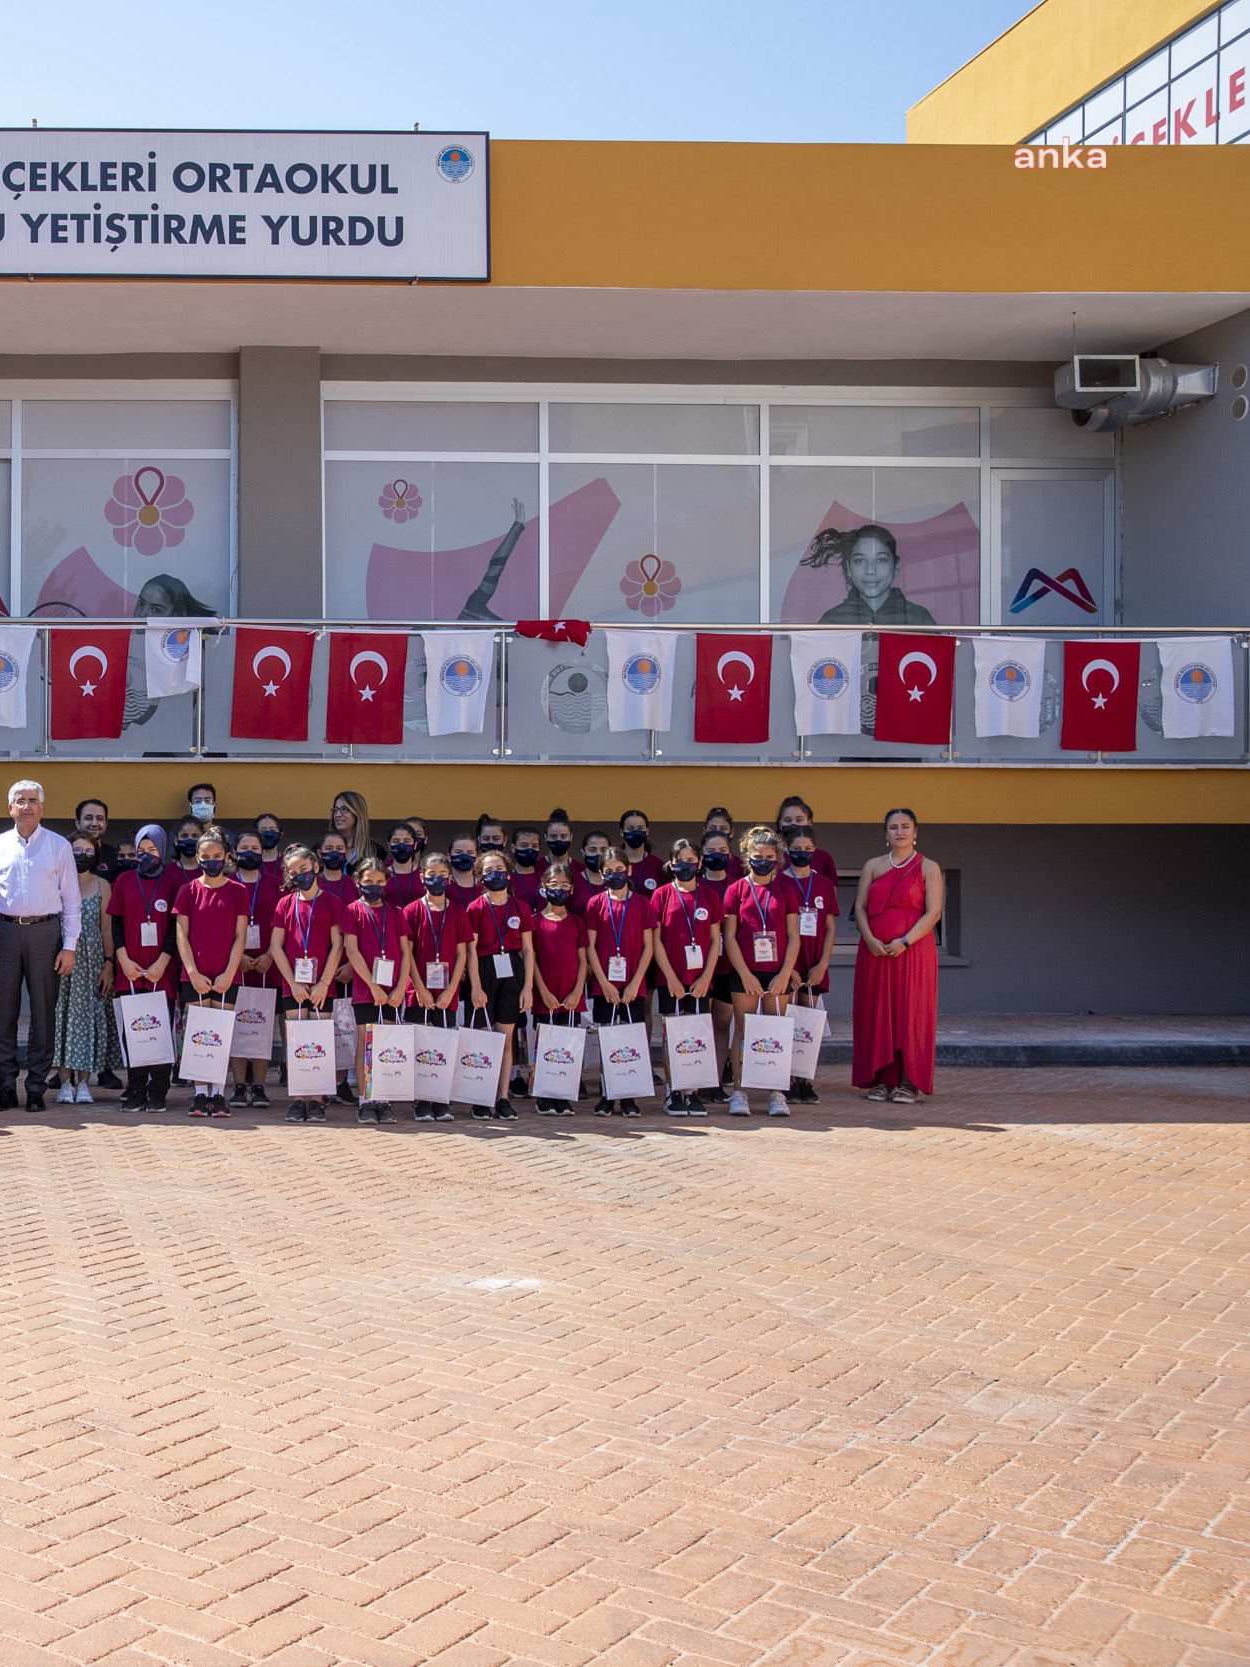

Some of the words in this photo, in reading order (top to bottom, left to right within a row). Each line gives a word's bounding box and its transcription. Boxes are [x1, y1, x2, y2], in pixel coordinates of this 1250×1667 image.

[173, 162, 399, 194] ORTAOKUL
[20, 203, 247, 252] YETİŞTİRME
[261, 215, 403, 246] YURDU
